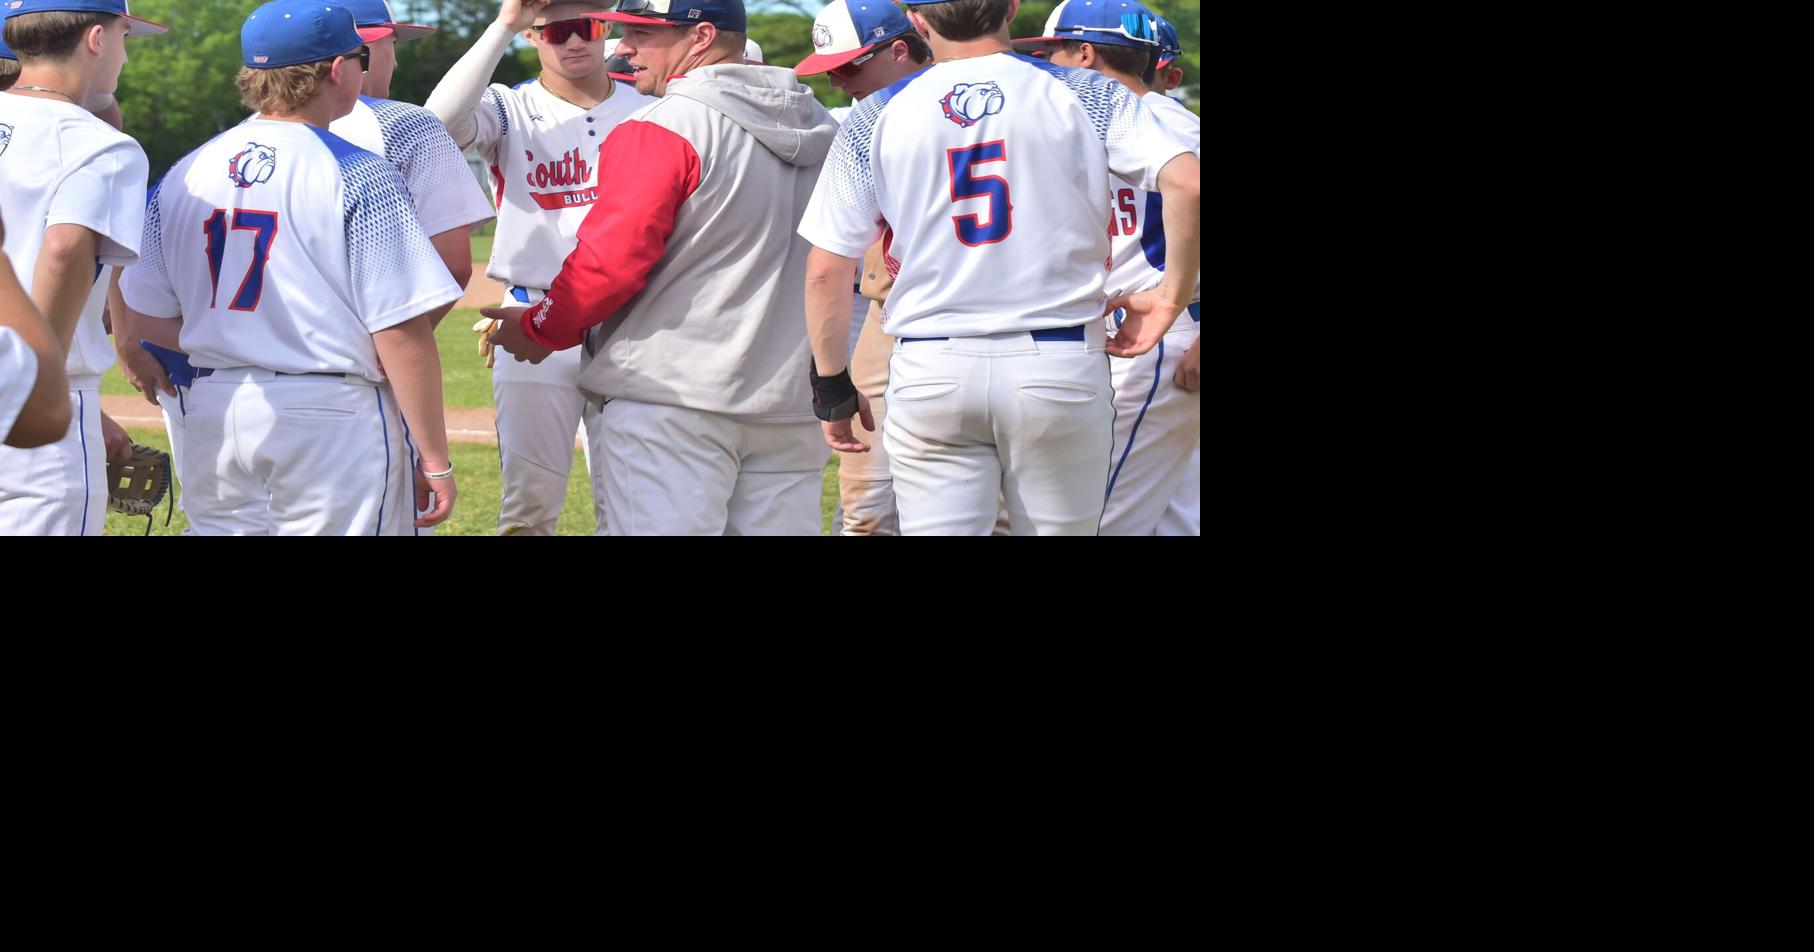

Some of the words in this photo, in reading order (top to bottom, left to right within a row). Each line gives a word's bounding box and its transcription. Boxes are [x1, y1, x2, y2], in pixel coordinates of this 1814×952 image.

[563, 190, 599, 205] BULL
[946, 138, 1014, 247] 5
[203, 207, 279, 312] 17
